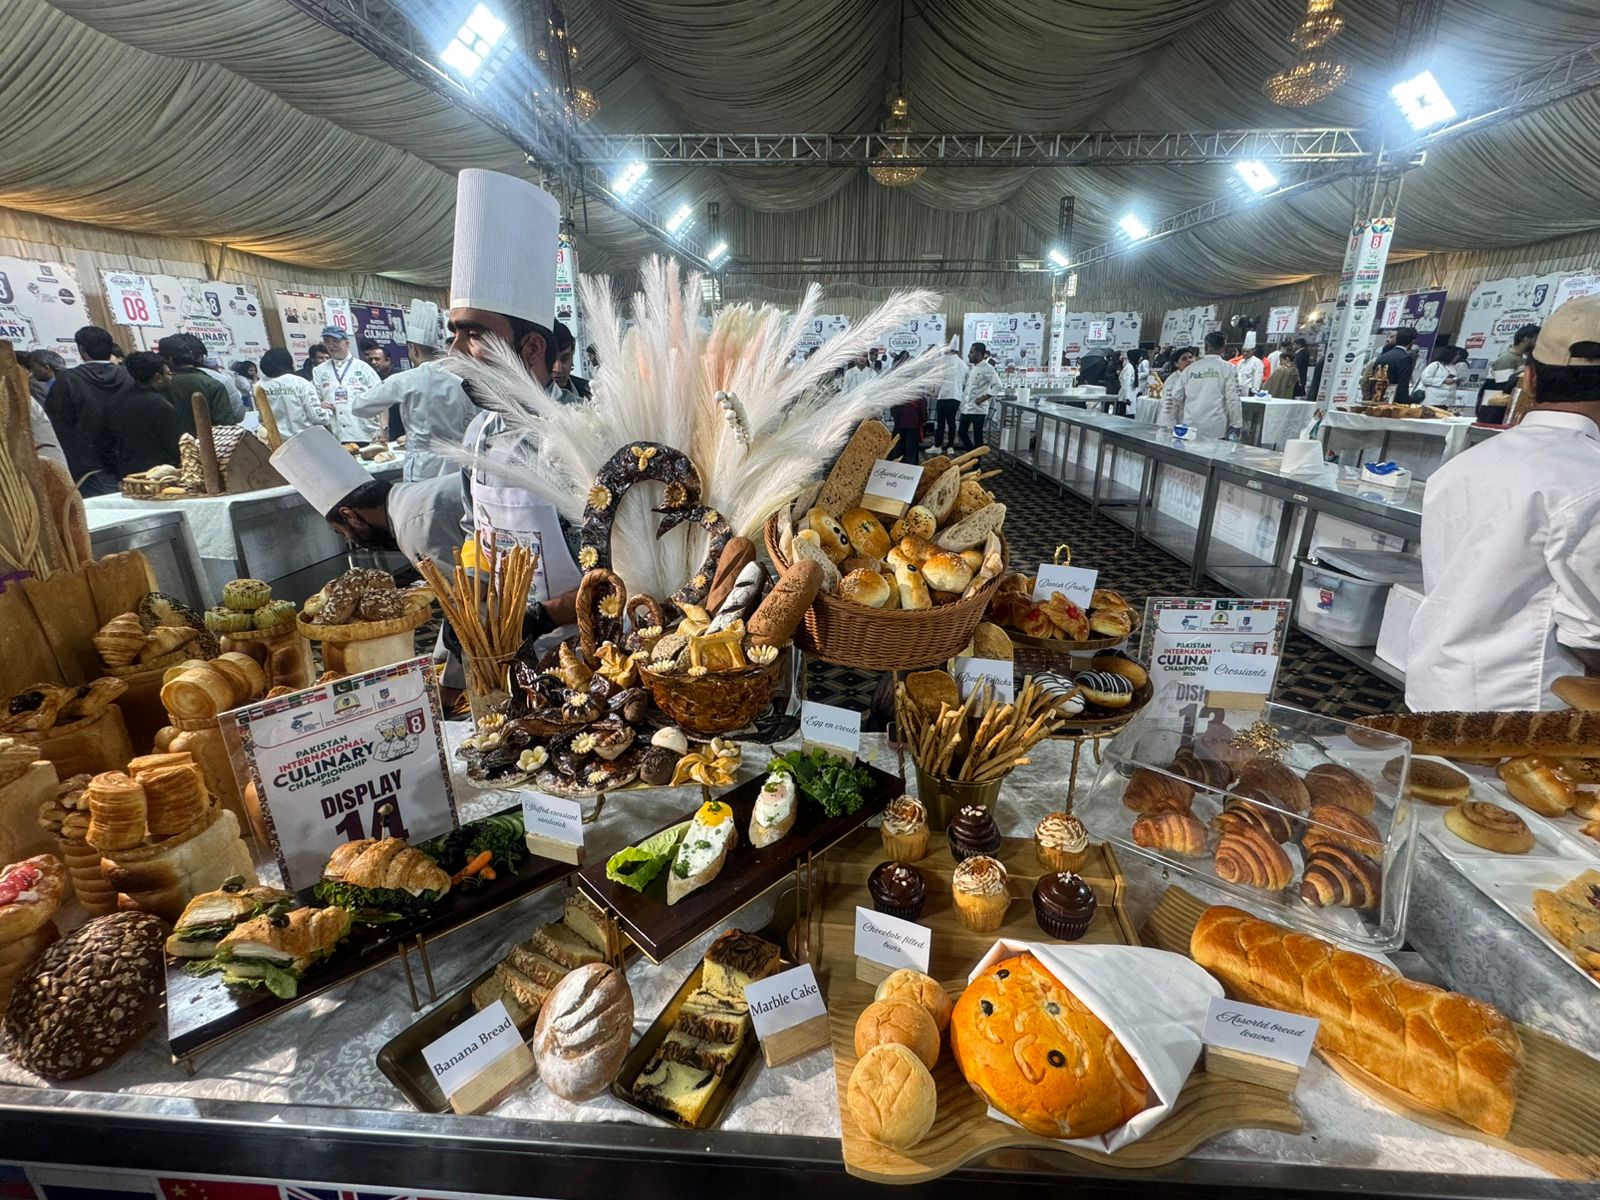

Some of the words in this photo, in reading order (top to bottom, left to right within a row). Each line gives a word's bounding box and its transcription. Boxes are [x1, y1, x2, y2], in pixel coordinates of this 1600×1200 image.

[209, 298, 218, 313] 8
[1534, 290, 1544, 304] 8
[122, 296, 150, 321] 08
[1386, 311, 1397, 325] 18
[1093, 330, 1102, 338] 15
[1276, 319, 1288, 331] 17
[411, 716, 422, 733] 8
[803, 715, 824, 728] Egg
[278, 738, 367, 773] INTERNATIONAL
[295, 735, 349, 759] PAKISTAN
[273, 741, 375, 788] CULINARY
[288, 758, 368, 792] CHAMPIONSHIP
[320, 768, 402, 819] DISPLAY
[335, 793, 410, 842] 14
[524, 801, 550, 814] Stuffed
[862, 922, 902, 941] Chocolate
[901, 936, 925, 949] filled
[883, 941, 901, 953] buns
[750, 993, 790, 1016] Marble
[791, 984, 817, 1001] Cake
[1270, 1023, 1307, 1038] bread
[433, 1042, 479, 1077] Banana
[478, 1016, 512, 1046] Bread
